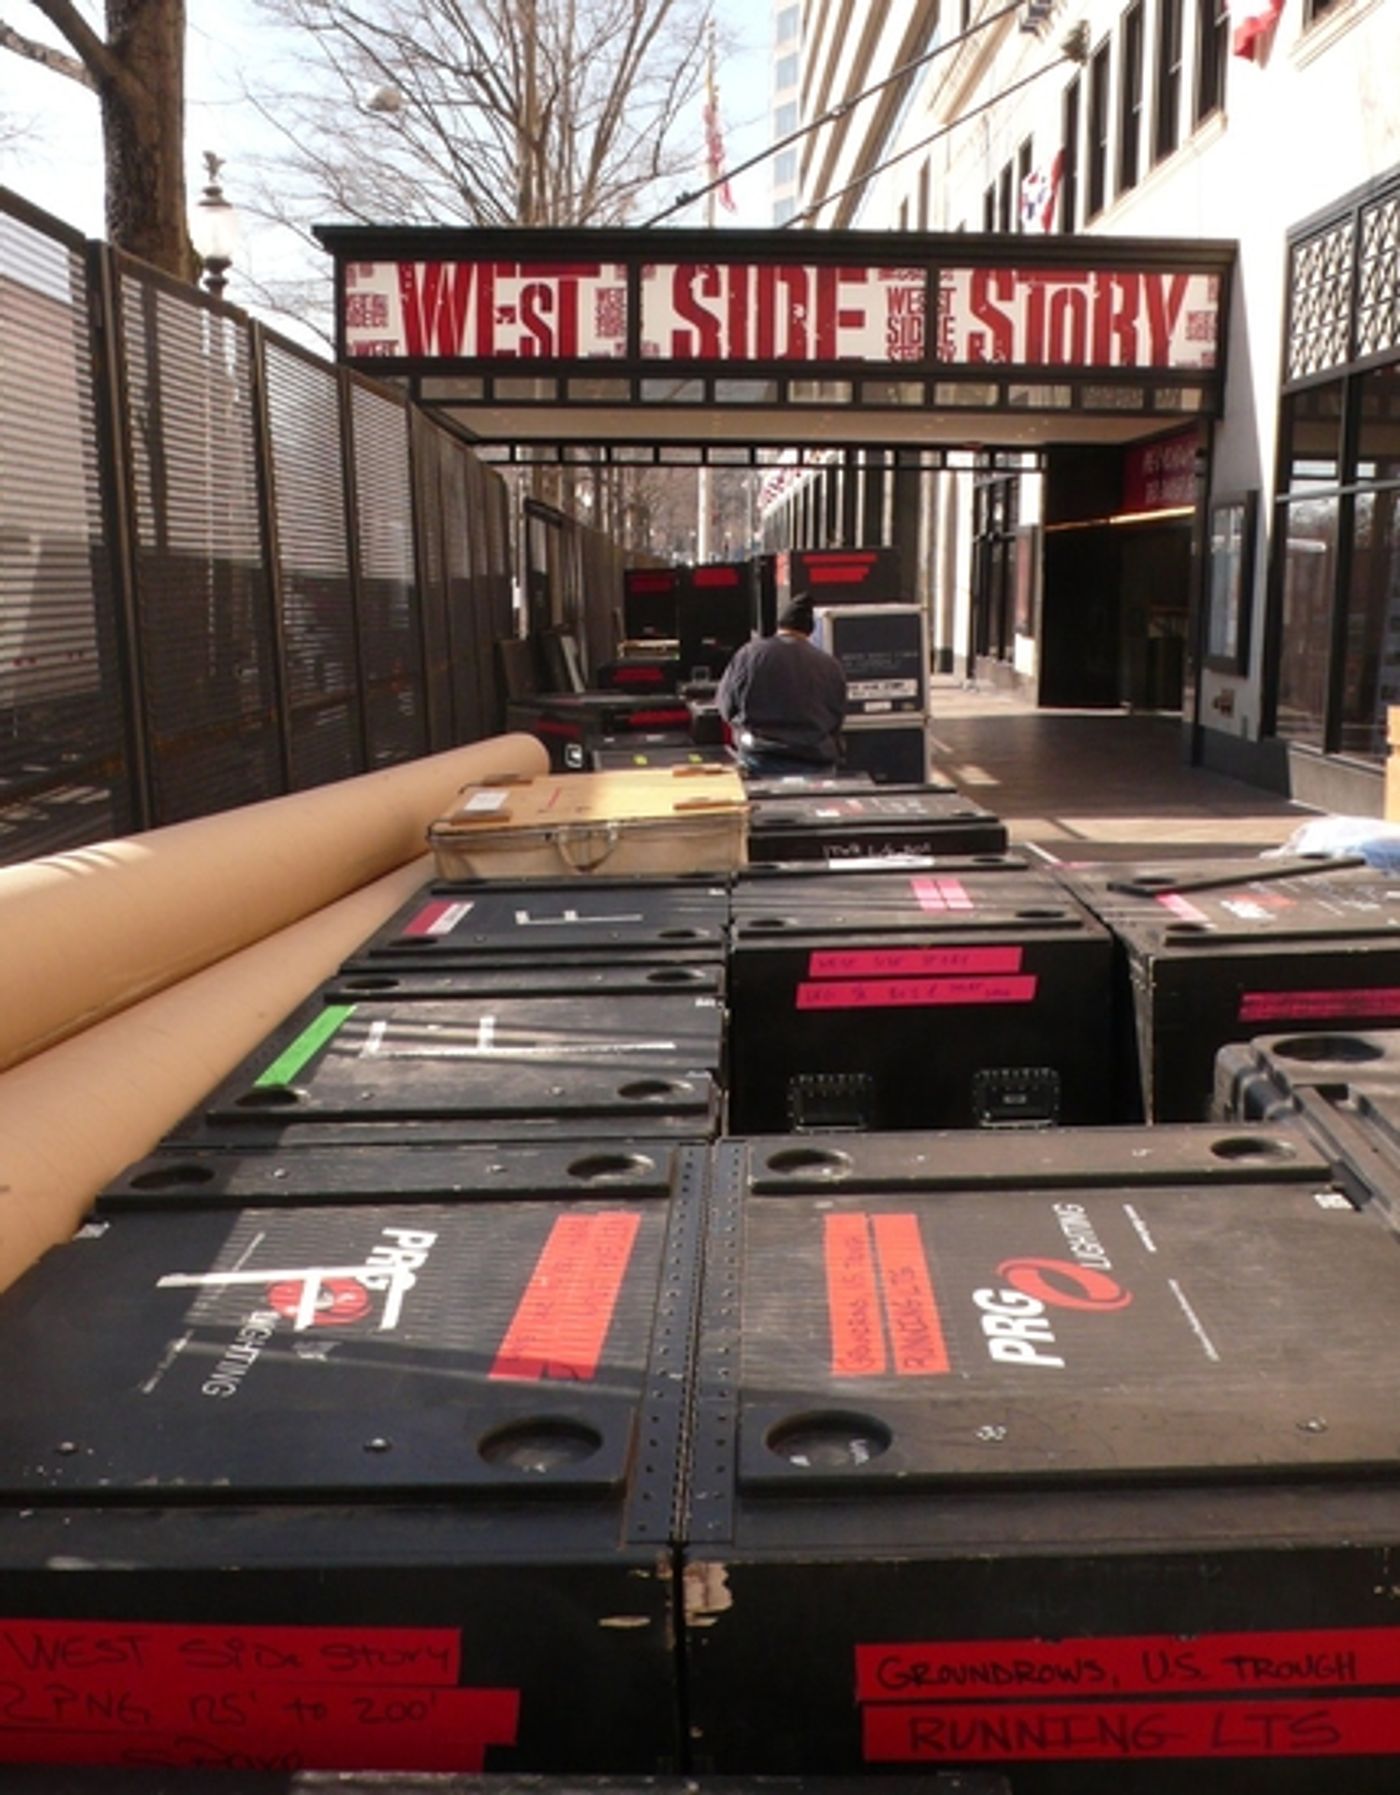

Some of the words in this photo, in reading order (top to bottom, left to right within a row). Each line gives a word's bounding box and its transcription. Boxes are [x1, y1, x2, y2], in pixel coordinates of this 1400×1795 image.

[397, 262, 601, 358] WEST
[671, 263, 868, 361] SIDE
[966, 266, 1191, 368] STORY
[1052, 1203, 1113, 1271] LIGHTING
[201, 1309, 281, 1398] LIGHTING
[972, 1287, 1066, 1368] PRG
[3, 1632, 151, 1673] WEST
[319, 1643, 451, 1674] Story
[1222, 1650, 1359, 1685] TROUGH
[282, 1696, 329, 1724] to
[908, 1713, 1190, 1755] RUNNING
[1209, 1708, 1343, 1751] LTS
